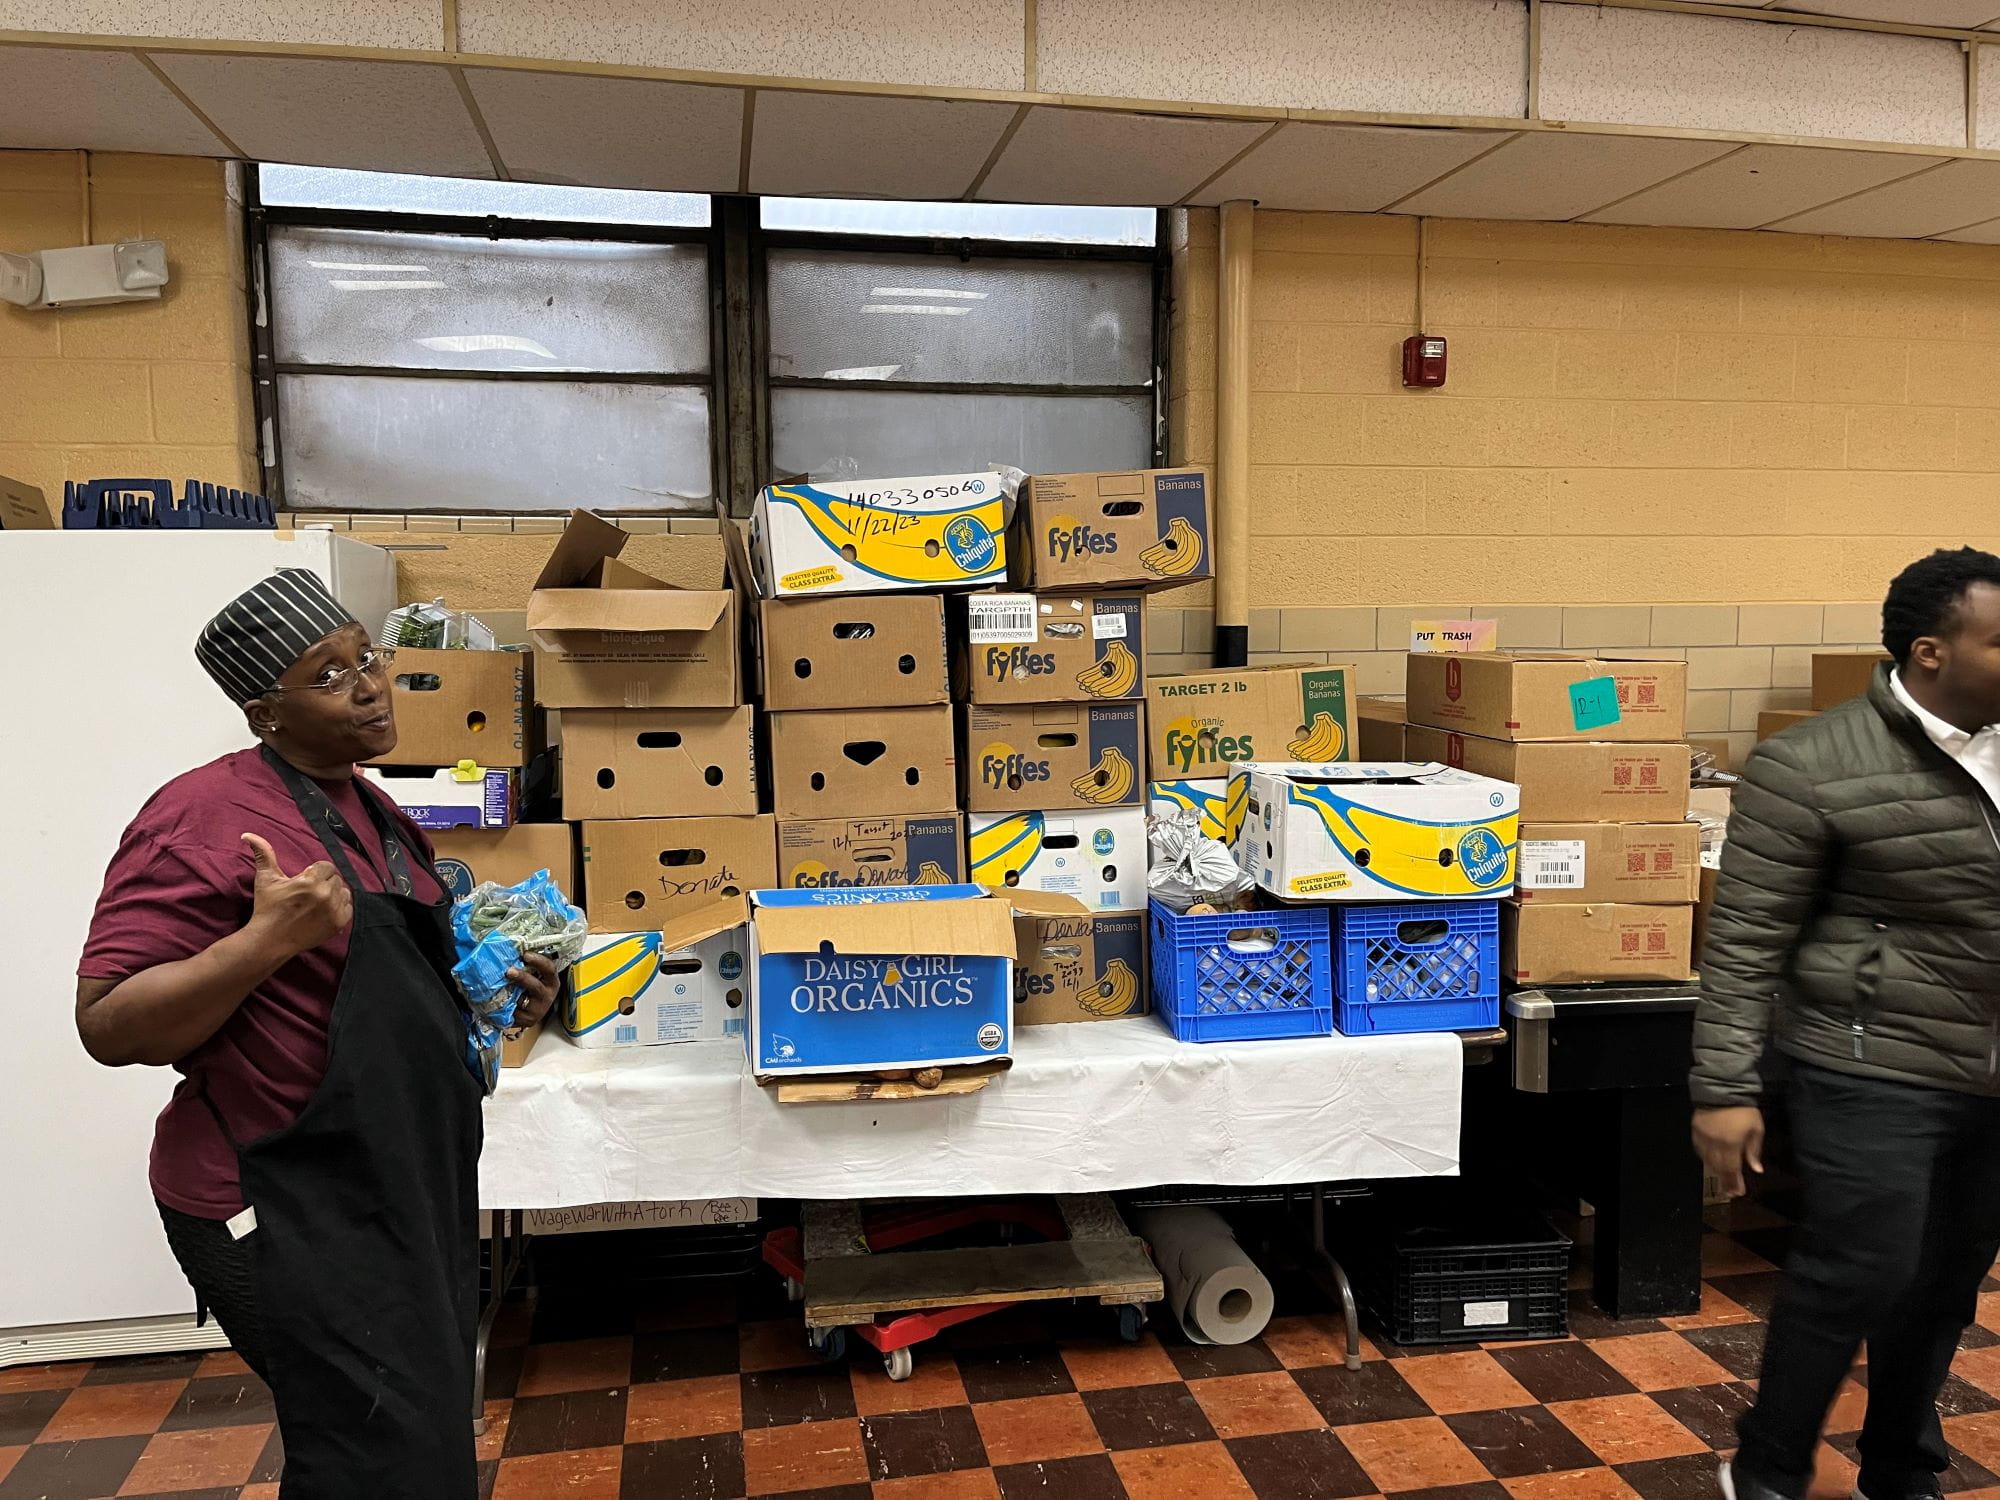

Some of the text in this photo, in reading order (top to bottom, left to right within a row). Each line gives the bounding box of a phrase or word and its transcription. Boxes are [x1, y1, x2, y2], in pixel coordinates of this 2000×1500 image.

[1158, 479, 1202, 491] Bananas
[848, 512, 921, 543] 11/22/23
[955, 536, 995, 569] Chiquita
[785, 567, 835, 582] SELECTED QUALITY
[789, 574, 835, 589] CLASS EXTRA
[1096, 603, 1138, 613] Bananas
[601, 632, 665, 645] biologique
[1416, 632, 1472, 641] PUT TRASH
[1158, 681, 1247, 697] TARGET 2 lb
[1309, 679, 1339, 690] Organic
[1308, 689, 1341, 699] Bananas
[1091, 711, 1135, 721] Bananas
[1191, 717, 1225, 729] Organic
[1467, 850, 1507, 882] Chiquita
[658, 865, 740, 901] Donate
[1296, 873, 1346, 886] SELECTED QUALITY
[1300, 879, 1347, 893] CLASS EXTRA
[1096, 922, 1138, 933] Bananas
[804, 954, 963, 982] DAISY GIRL
[790, 975, 974, 1013] ORGANICS
